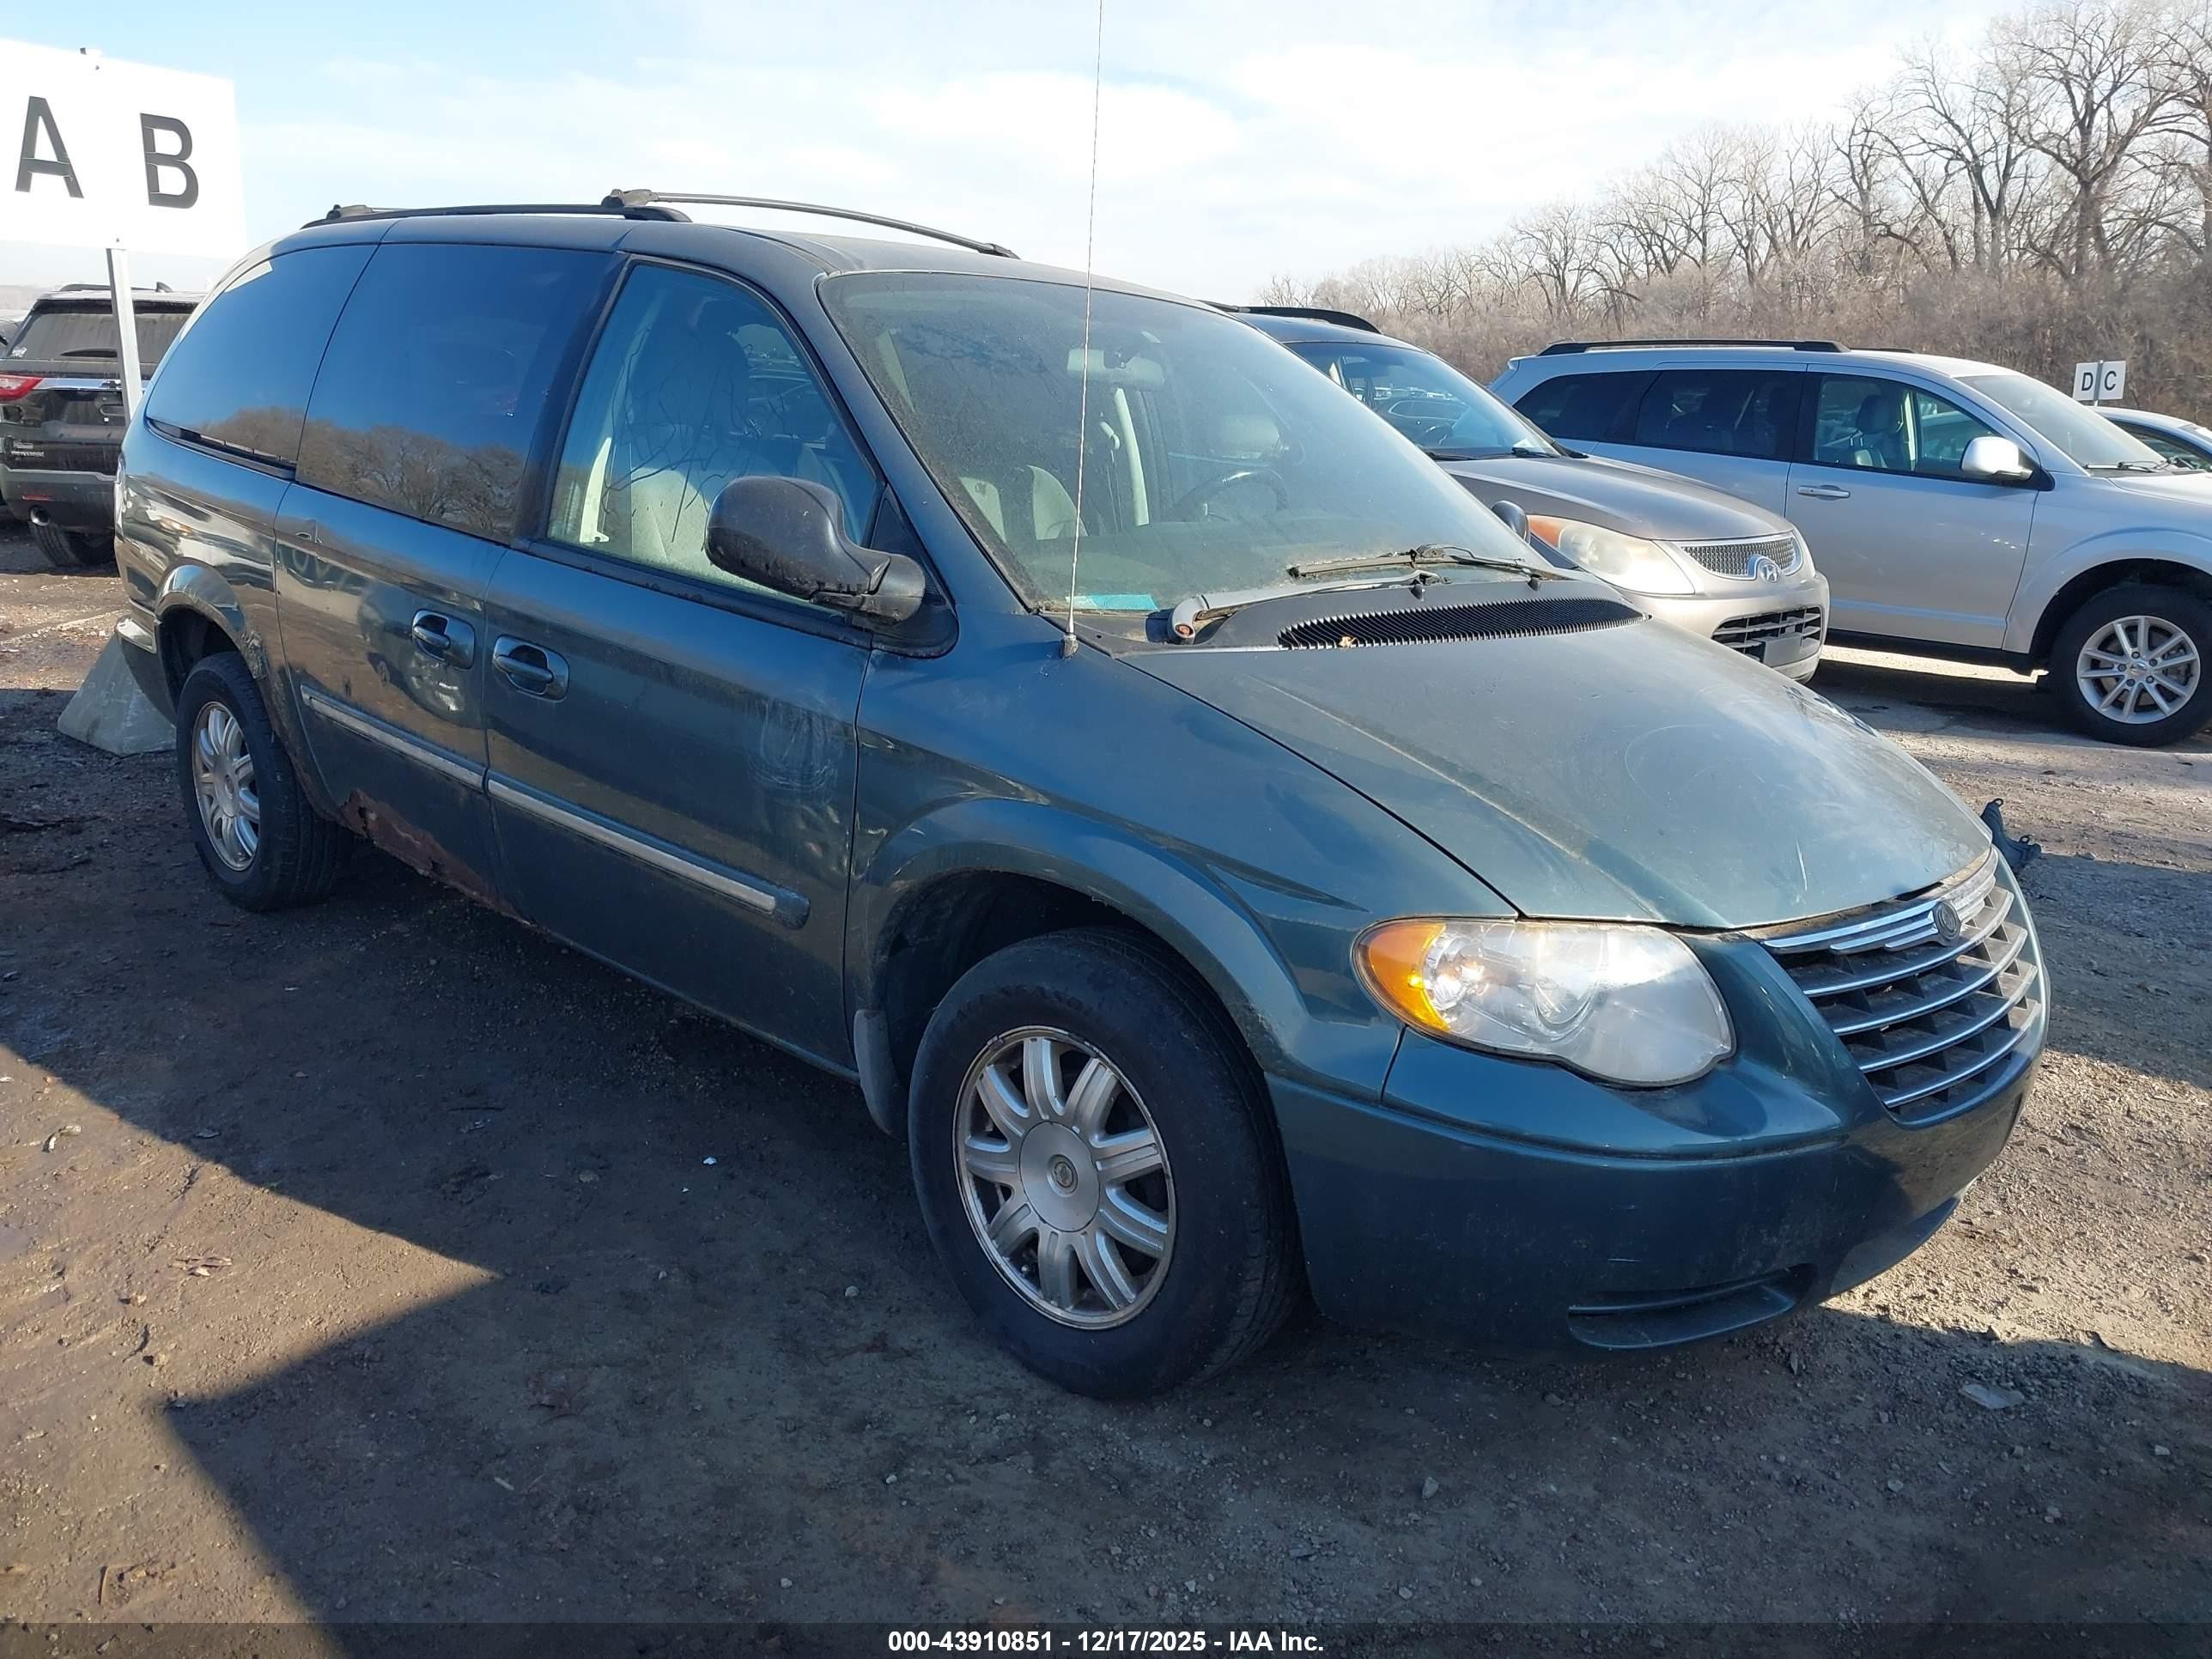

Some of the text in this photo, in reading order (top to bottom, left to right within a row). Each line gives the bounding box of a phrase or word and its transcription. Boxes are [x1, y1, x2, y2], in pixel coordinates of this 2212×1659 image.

[15, 95, 199, 209] A B
[2081, 370, 2117, 392] D C
